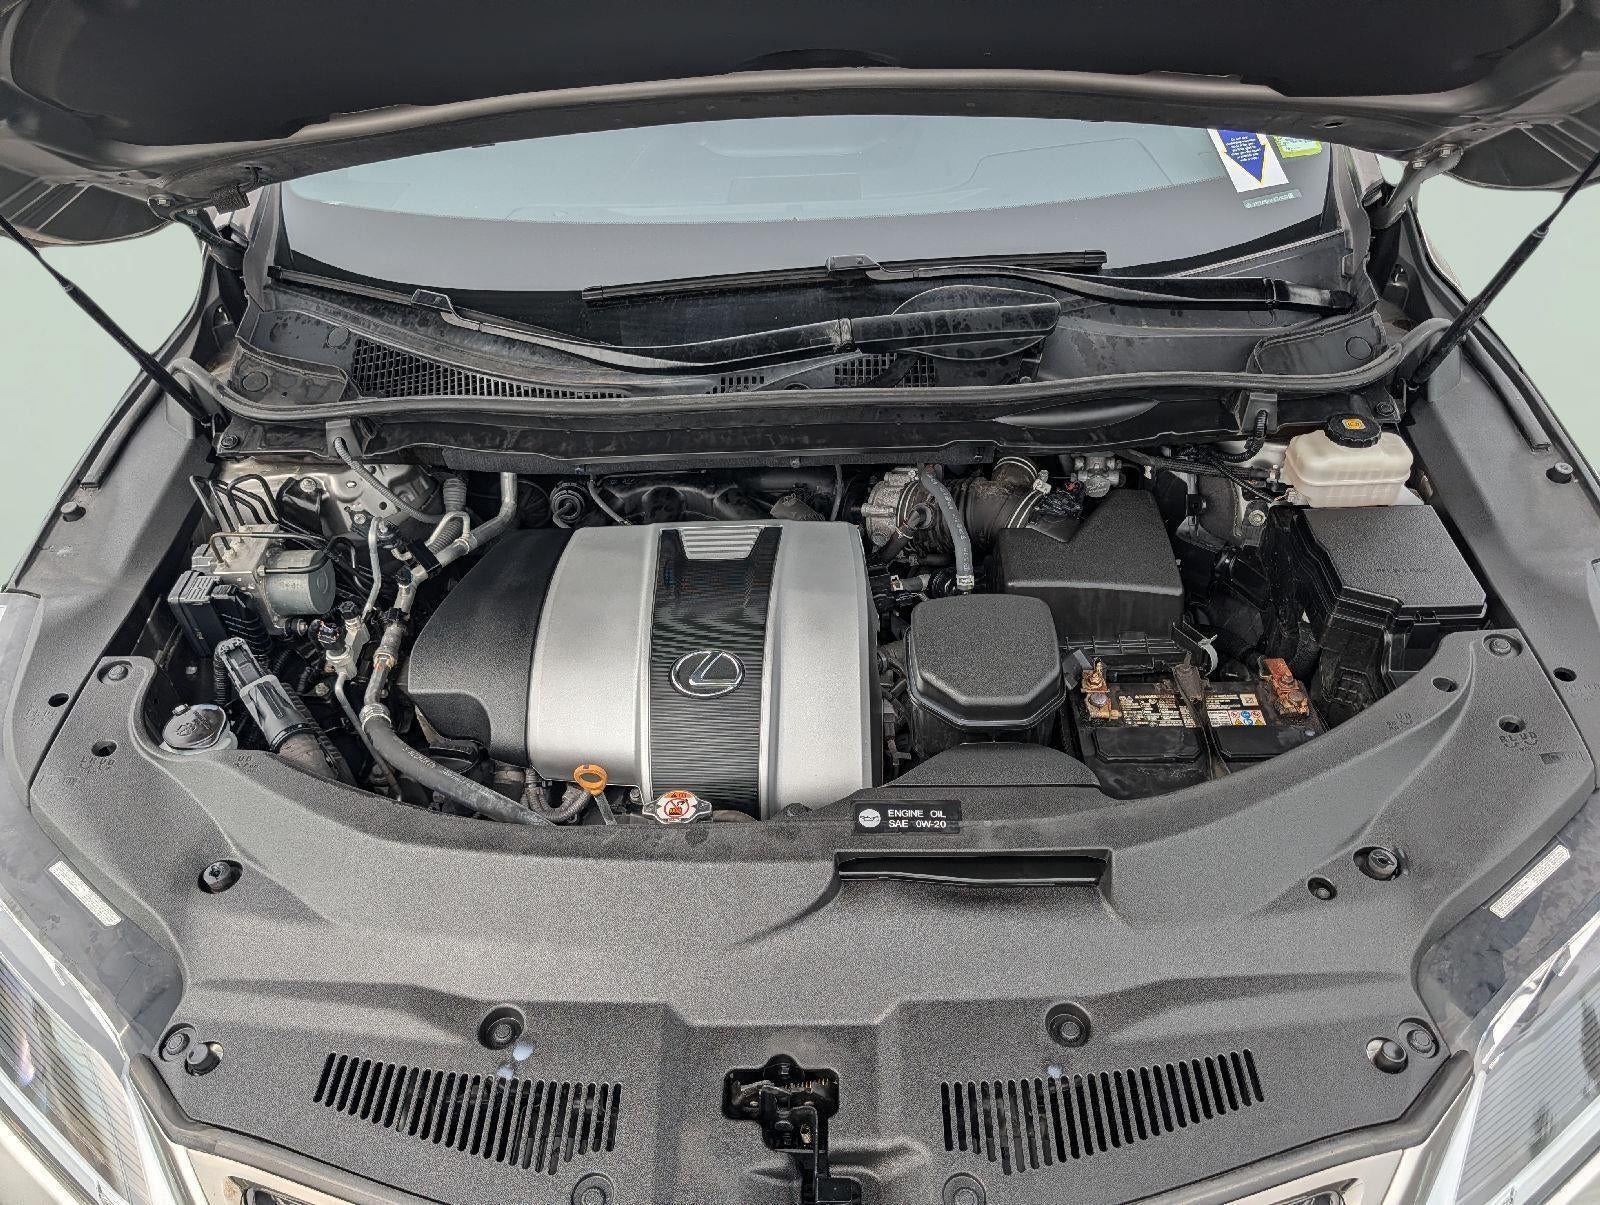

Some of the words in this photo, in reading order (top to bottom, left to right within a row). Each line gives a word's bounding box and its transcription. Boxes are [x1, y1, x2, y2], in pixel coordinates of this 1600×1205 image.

[887, 809, 924, 818] ENGINE
[930, 809, 947, 818] OIL
[888, 820, 909, 828] SAE
[915, 820, 947, 829] 0W-20
